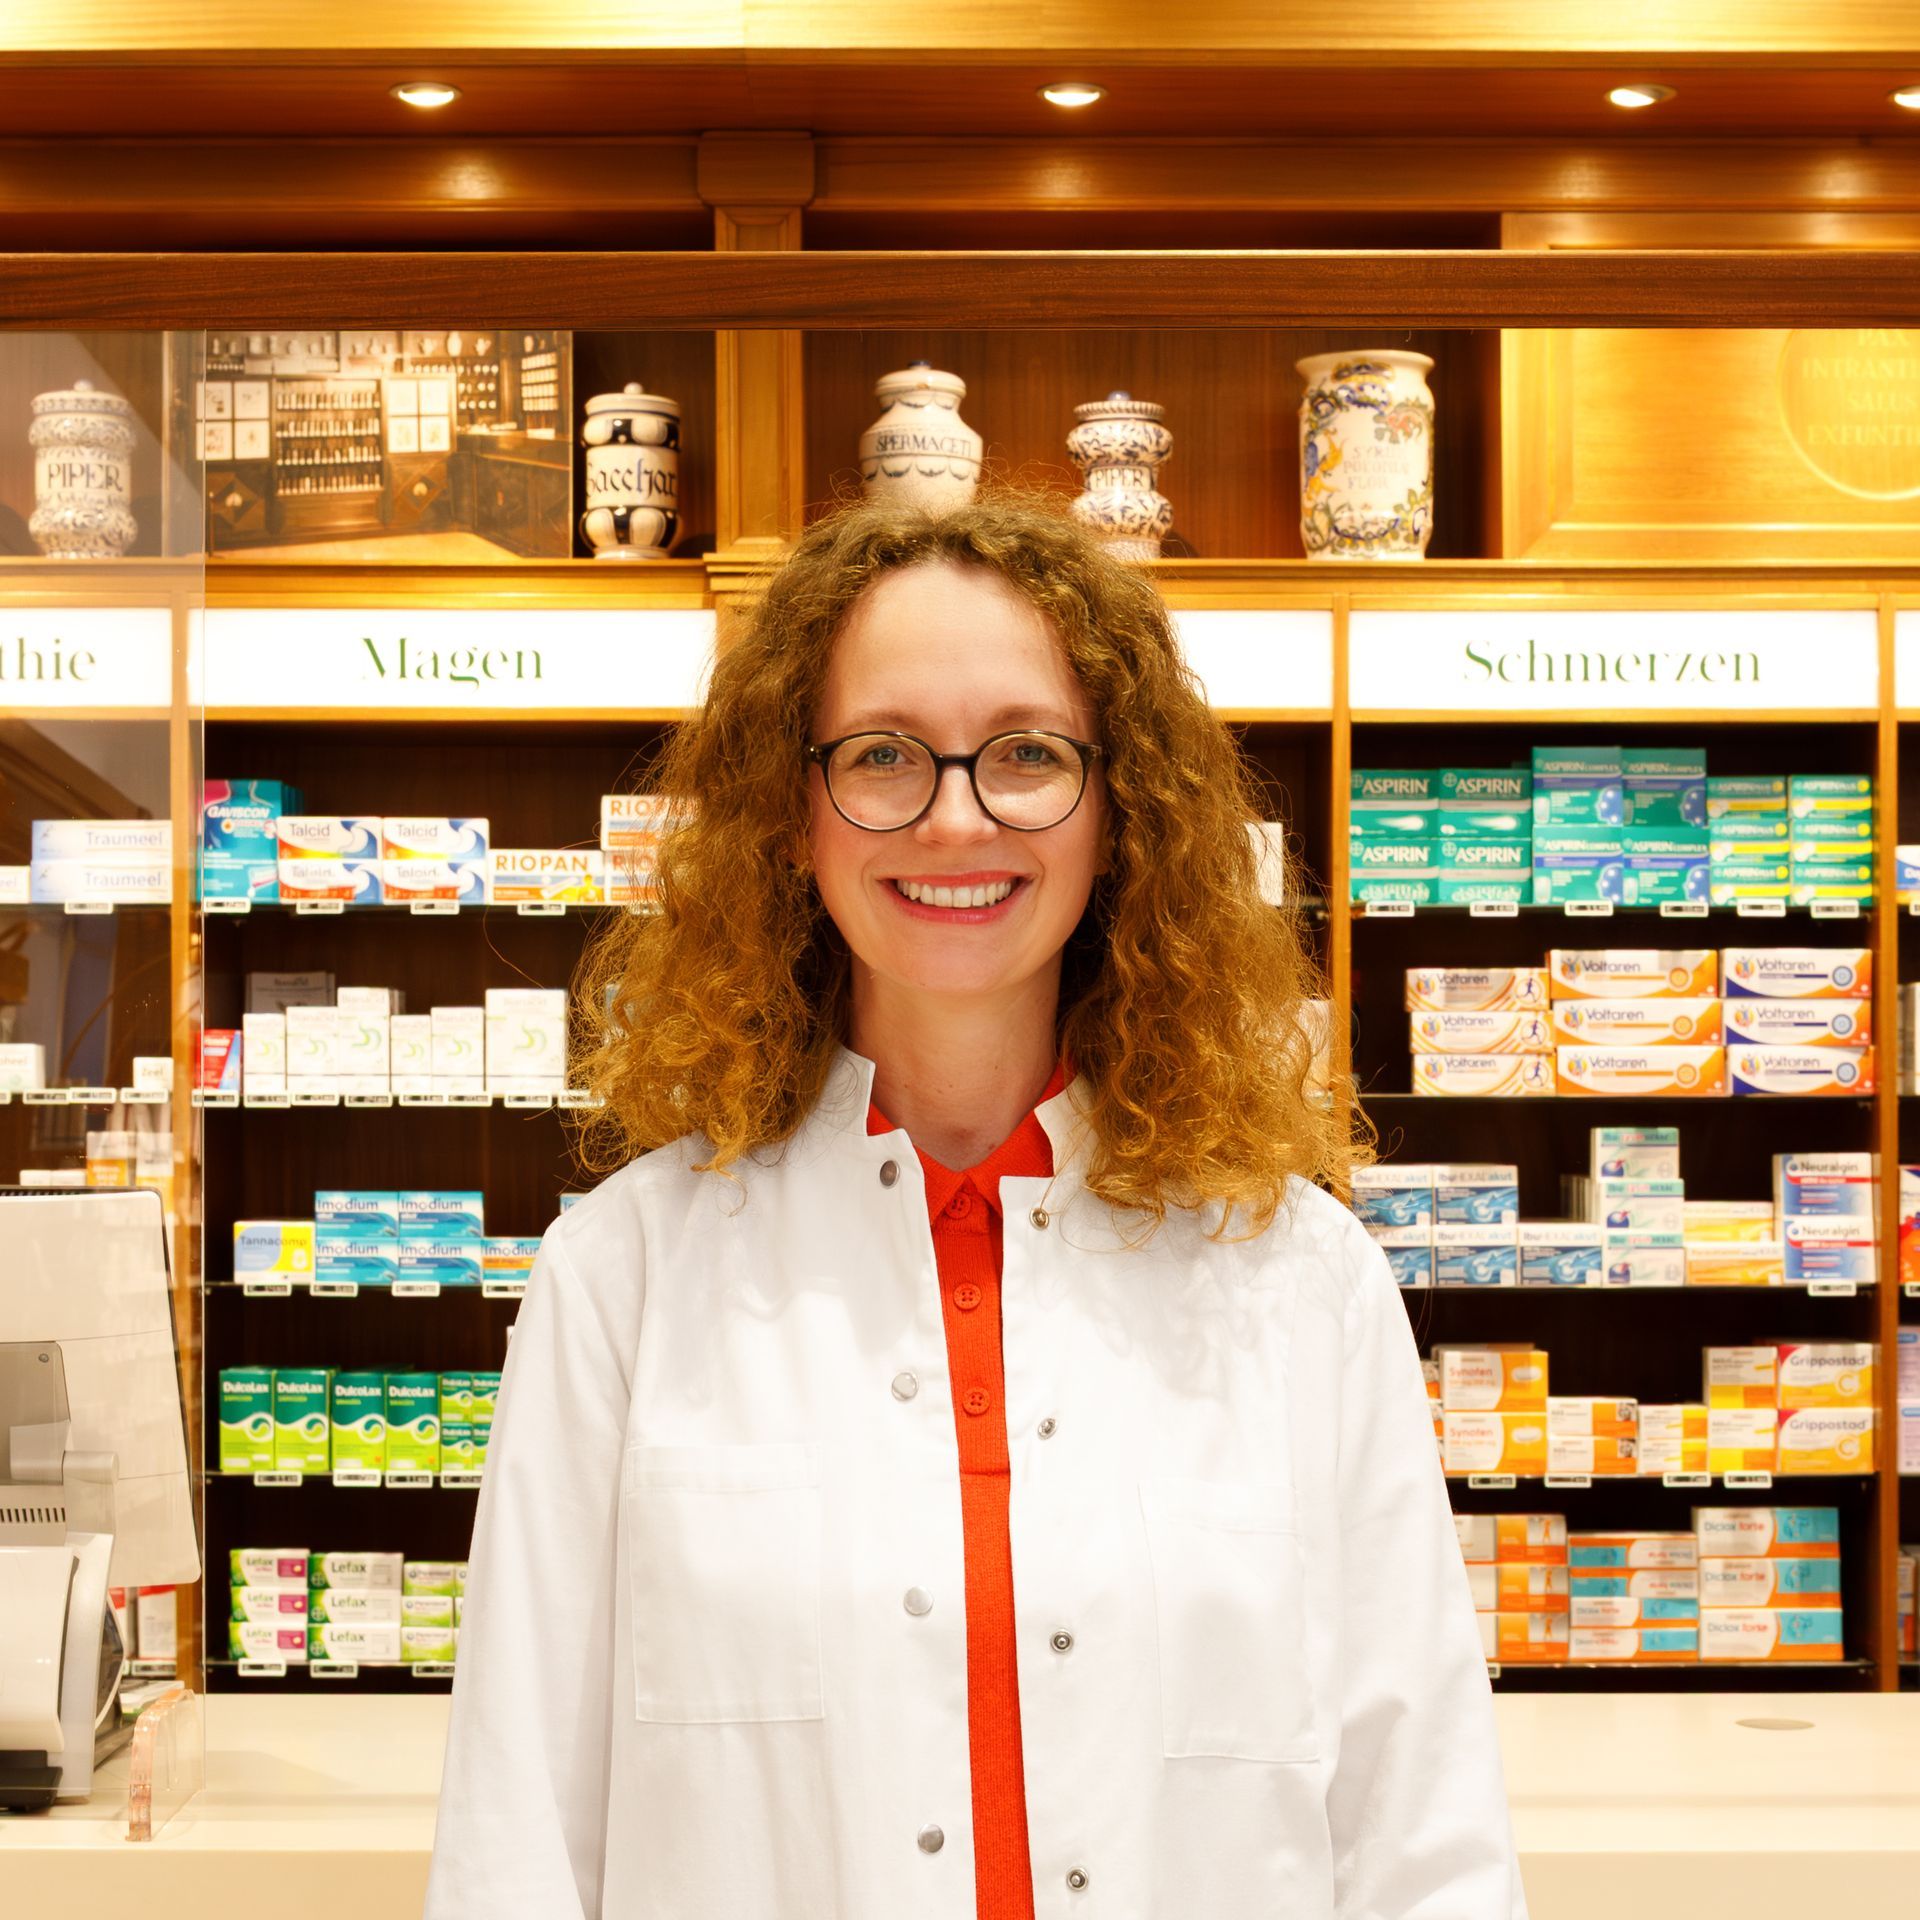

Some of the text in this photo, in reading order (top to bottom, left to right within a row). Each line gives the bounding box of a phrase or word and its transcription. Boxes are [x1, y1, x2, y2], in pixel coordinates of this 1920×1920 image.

[48, 462, 123, 492] PIPER
[1095, 466, 1145, 489] PIPER
[361, 637, 542, 691] Magen
[1464, 639, 1760, 683] Schmerzen
[1362, 778, 1428, 795] ASPIRIN
[1455, 778, 1521, 794] ASPIRIN
[207, 805, 271, 819] GAVISCON
[289, 823, 331, 836] Talcid
[398, 824, 439, 837] Talcid
[85, 831, 163, 847] Traumeel
[1362, 846, 1428, 863] ASPIRIN
[1454, 846, 1522, 863] ASPIRIN
[495, 854, 589, 872] RIOPAN
[85, 871, 162, 887] Traumeel
[1583, 960, 1641, 972] Voltaren
[1756, 958, 1815, 971] Voltaren
[1436, 973, 1489, 985] Voltaren
[1585, 1008, 1644, 1020] Voltaren
[1756, 1007, 1815, 1019] Voltaren
[1441, 1015, 1494, 1026] Voltaren
[1444, 1056, 1497, 1068] Voltaren
[1588, 1056, 1648, 1069] Voltaren
[1762, 1055, 1820, 1067] Voltaren
[1800, 1161, 1859, 1175] Neuralgin
[316, 1199, 379, 1211] Imodium
[400, 1197, 463, 1211] Imodium
[1802, 1226, 1860, 1240] Neuralgin
[239, 1236, 307, 1248] Tannacomp
[316, 1243, 379, 1255] Imodium
[400, 1242, 462, 1256] Imodium
[1790, 1355, 1866, 1369] Grippostad
[1790, 1418, 1867, 1433] Grippostad
[1738, 1520, 1765, 1531] forte
[246, 1556, 273, 1566] Lefax
[331, 1561, 367, 1574] Lefax
[1739, 1571, 1766, 1581] forte
[331, 1596, 367, 1608] Lefax
[1741, 1622, 1768, 1633] forte
[330, 1631, 365, 1643] Lefax
